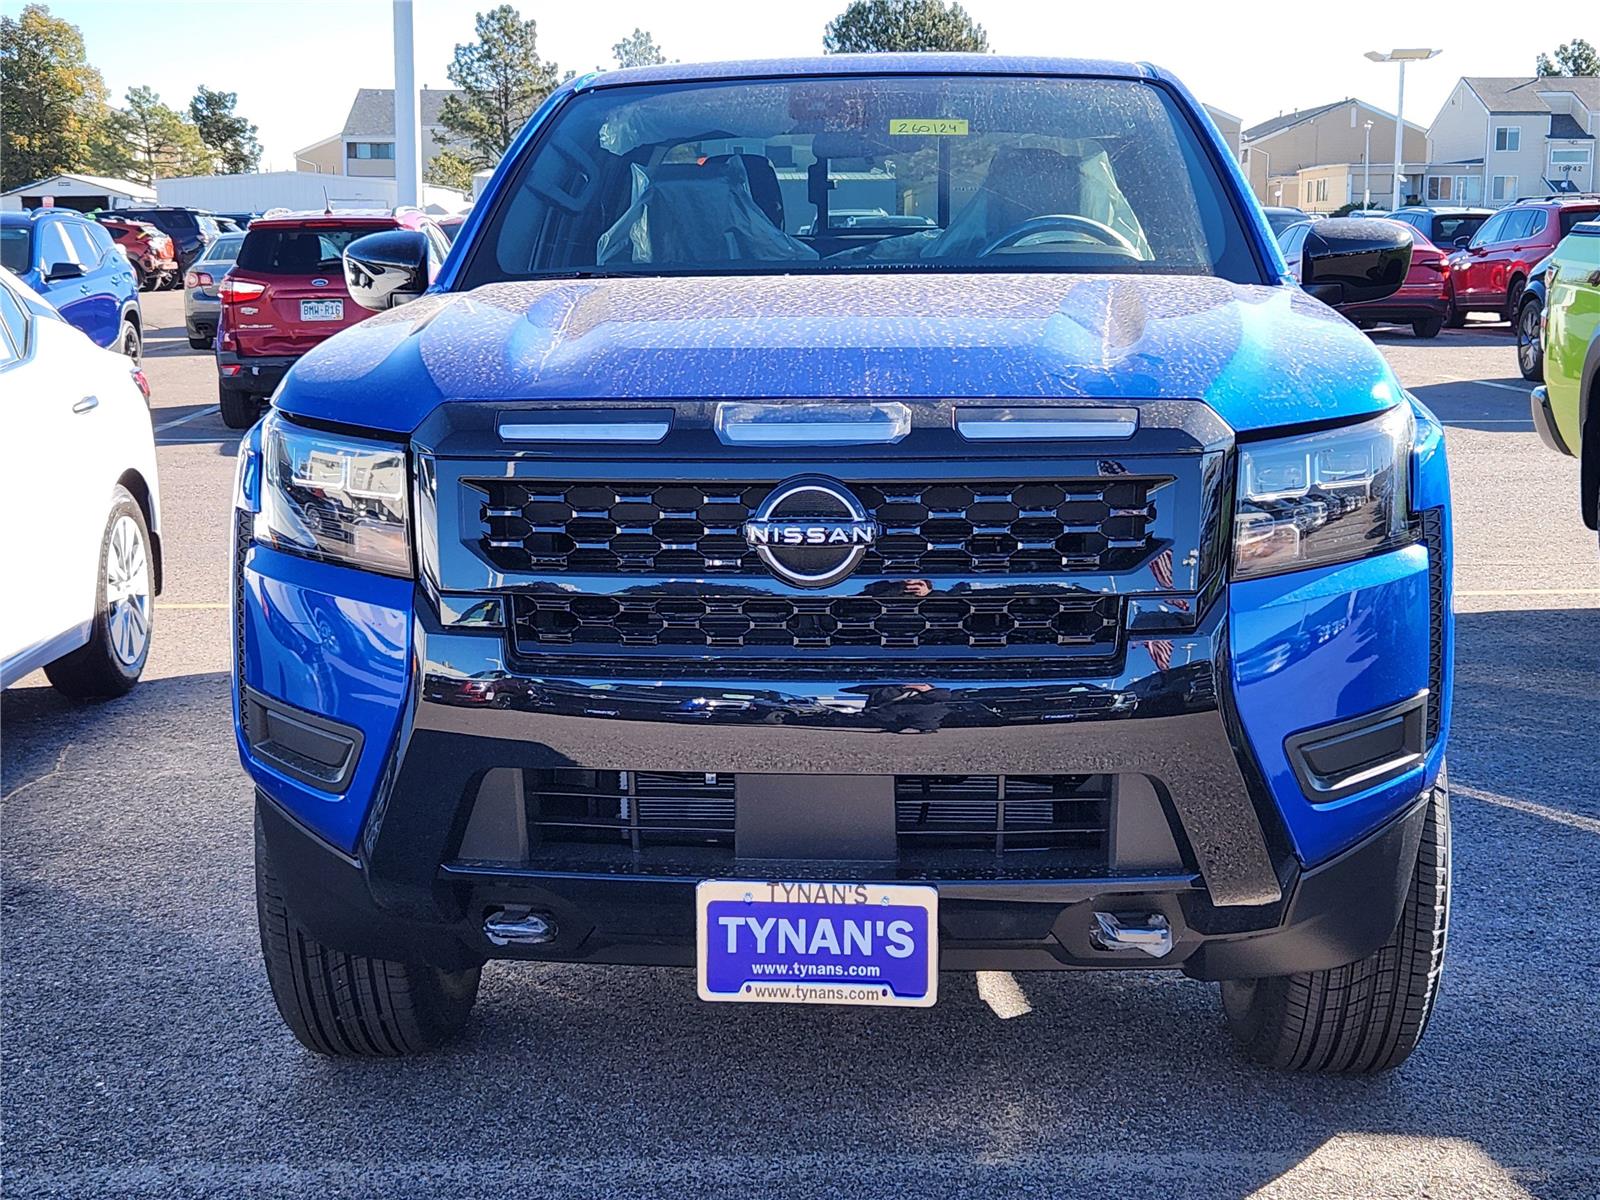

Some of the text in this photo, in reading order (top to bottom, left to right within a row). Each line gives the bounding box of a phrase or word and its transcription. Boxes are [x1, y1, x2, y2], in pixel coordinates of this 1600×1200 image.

[898, 123, 957, 133] 260124
[748, 526, 873, 543] NISSAN
[767, 882, 868, 904] TYNAN'S
[718, 916, 915, 958] TYNAN'S
[751, 962, 881, 977] www.tynans.com
[755, 985, 880, 1001] www.tynans.com
